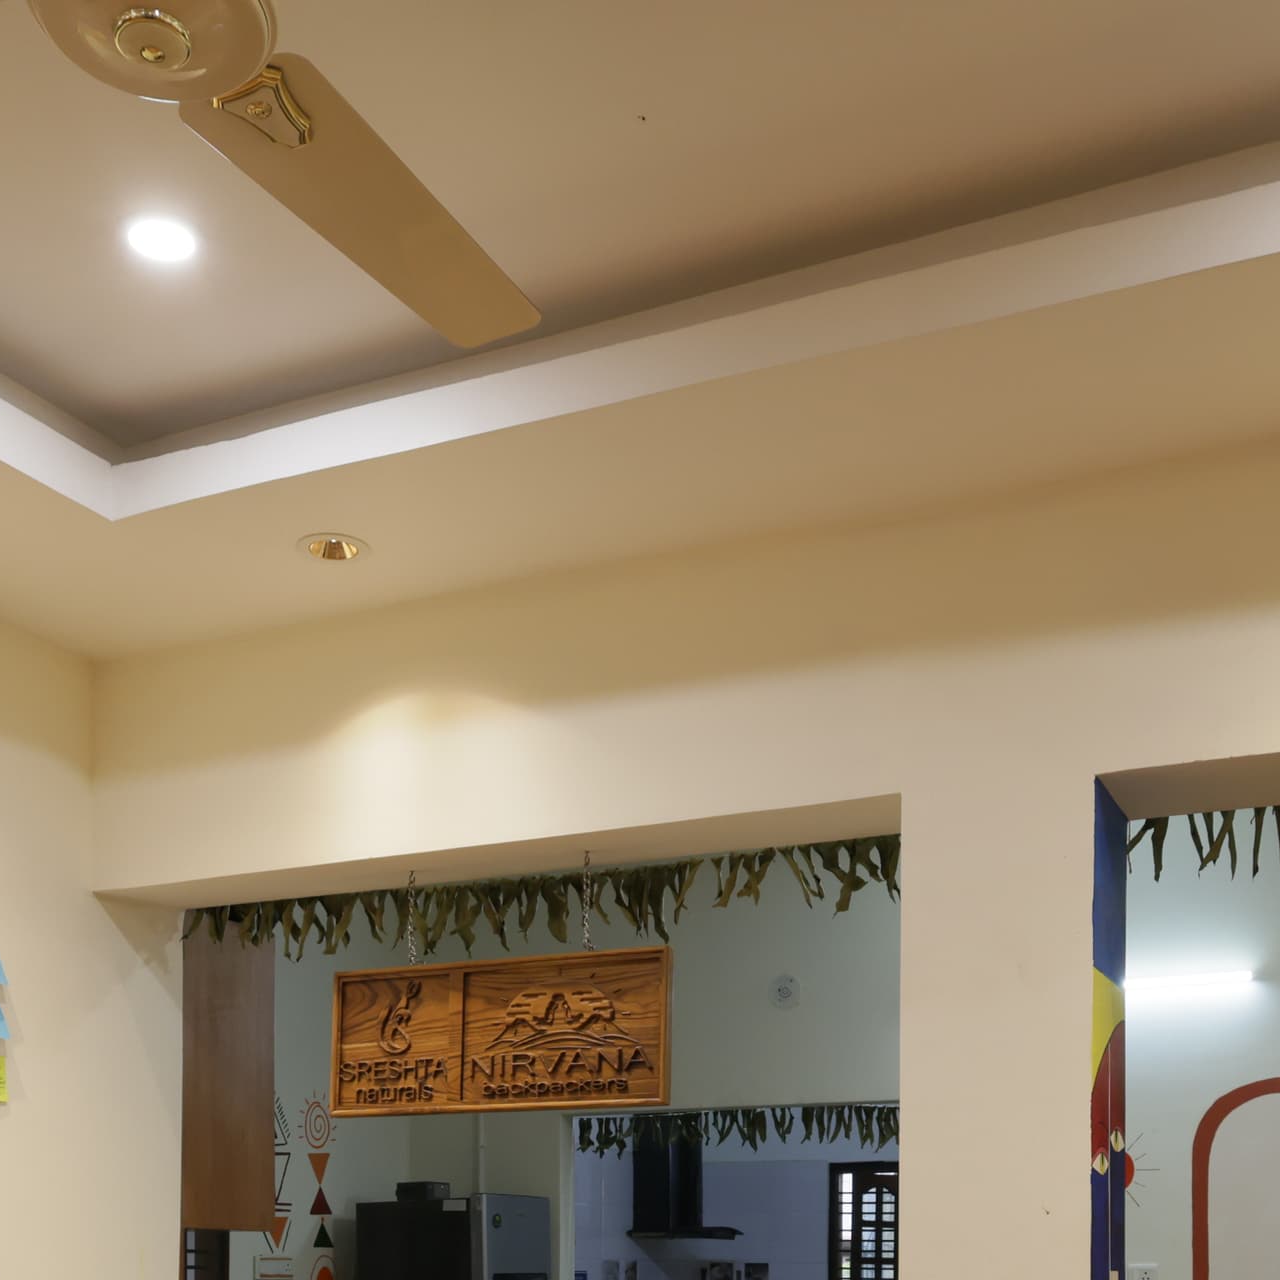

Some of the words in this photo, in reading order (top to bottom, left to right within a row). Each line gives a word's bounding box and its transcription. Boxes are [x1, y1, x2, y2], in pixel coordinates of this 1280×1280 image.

[339, 1056, 449, 1082] SRESHTA
[470, 1045, 655, 1080] NIRVANA
[355, 1083, 435, 1104] naturals
[481, 1078, 629, 1098] backpackers
